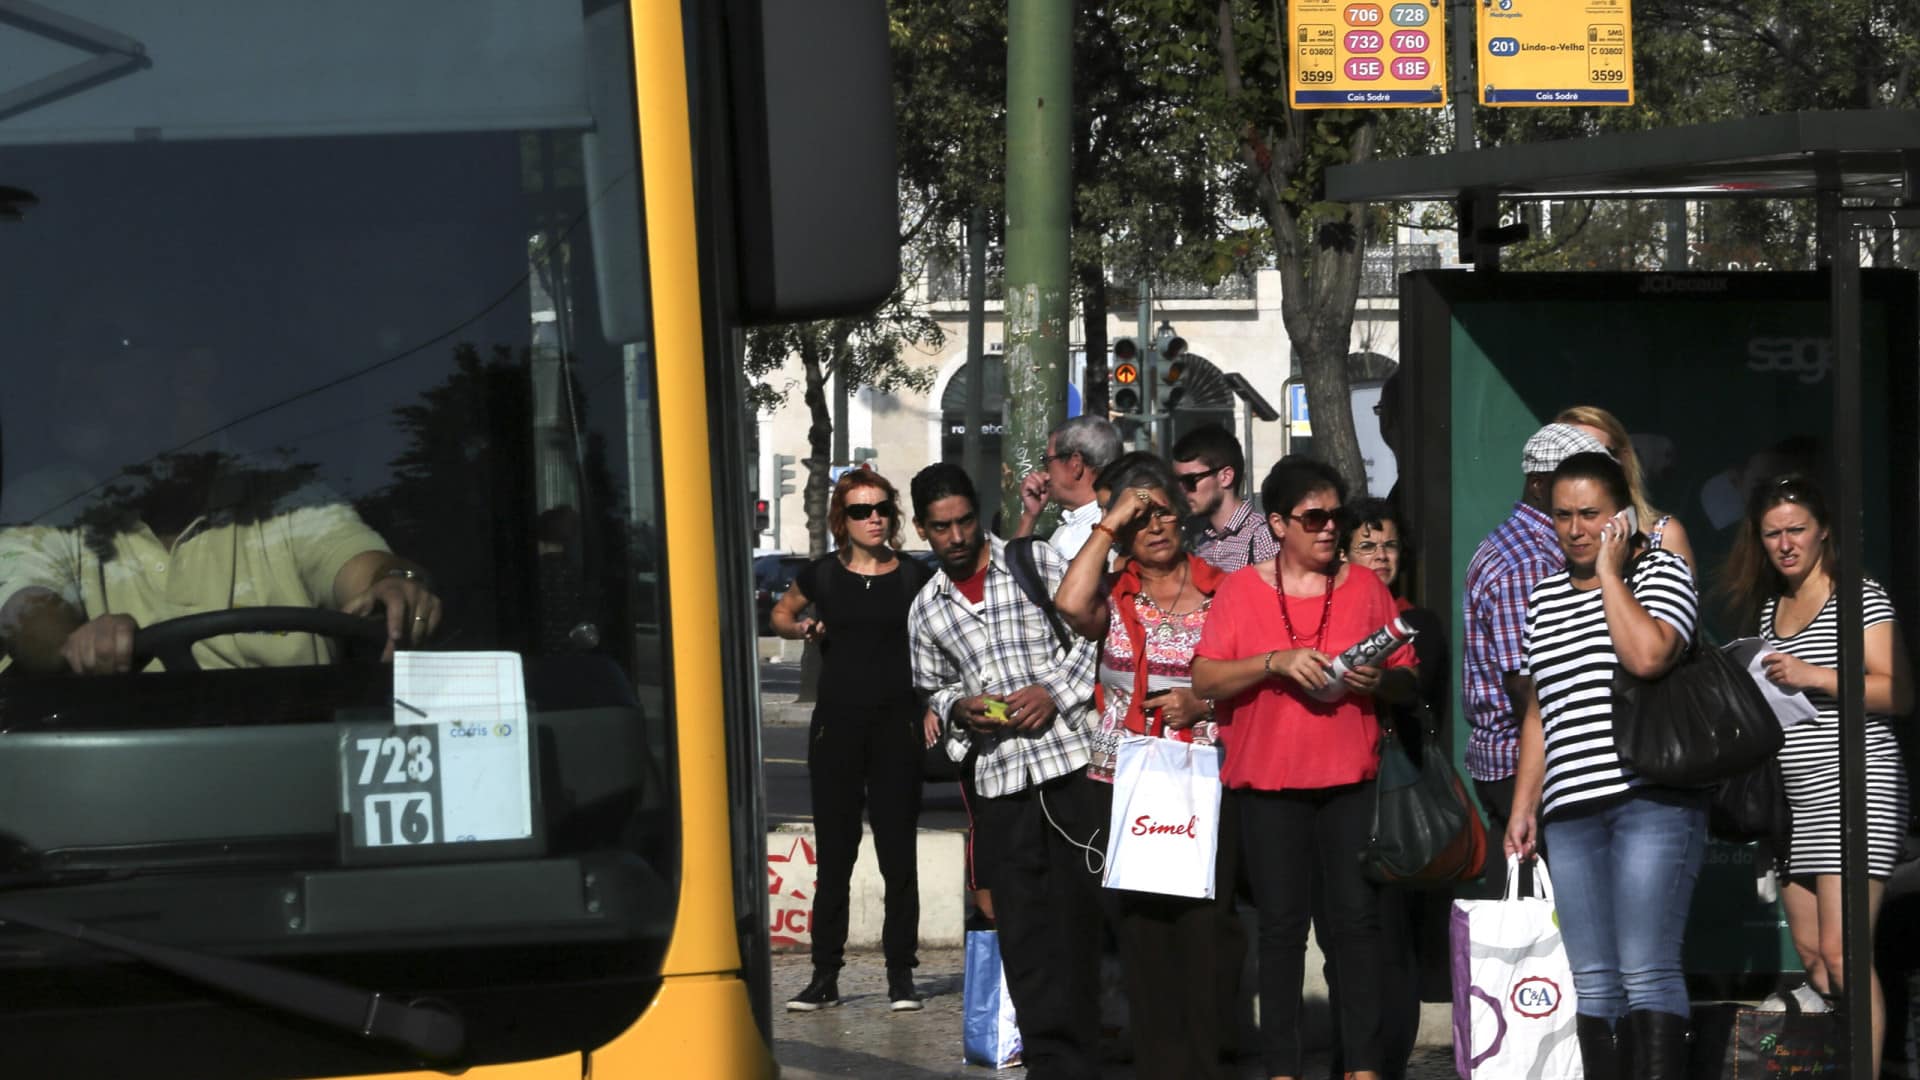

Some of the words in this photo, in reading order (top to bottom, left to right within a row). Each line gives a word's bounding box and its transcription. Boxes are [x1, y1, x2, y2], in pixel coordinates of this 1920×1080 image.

[1349, 9, 1378, 22] 706
[1396, 9, 1424, 22] 728
[1349, 35, 1379, 48] 732
[1396, 35, 1424, 48] 760
[1492, 41, 1514, 52] 201
[1521, 43, 1584, 51] Linda-a-Velha
[1350, 62, 1379, 75] 15E
[1397, 62, 1425, 75] 18E
[1301, 71, 1333, 81] 3599
[1592, 70, 1623, 81] 3599
[1347, 93, 1365, 101] Cais
[1536, 92, 1553, 100] Cais
[1639, 274, 1729, 293] JCDecaux
[373, 799, 429, 844] 16
[1131, 814, 1197, 839] Simel
[1518, 987, 1552, 1006] C&A
